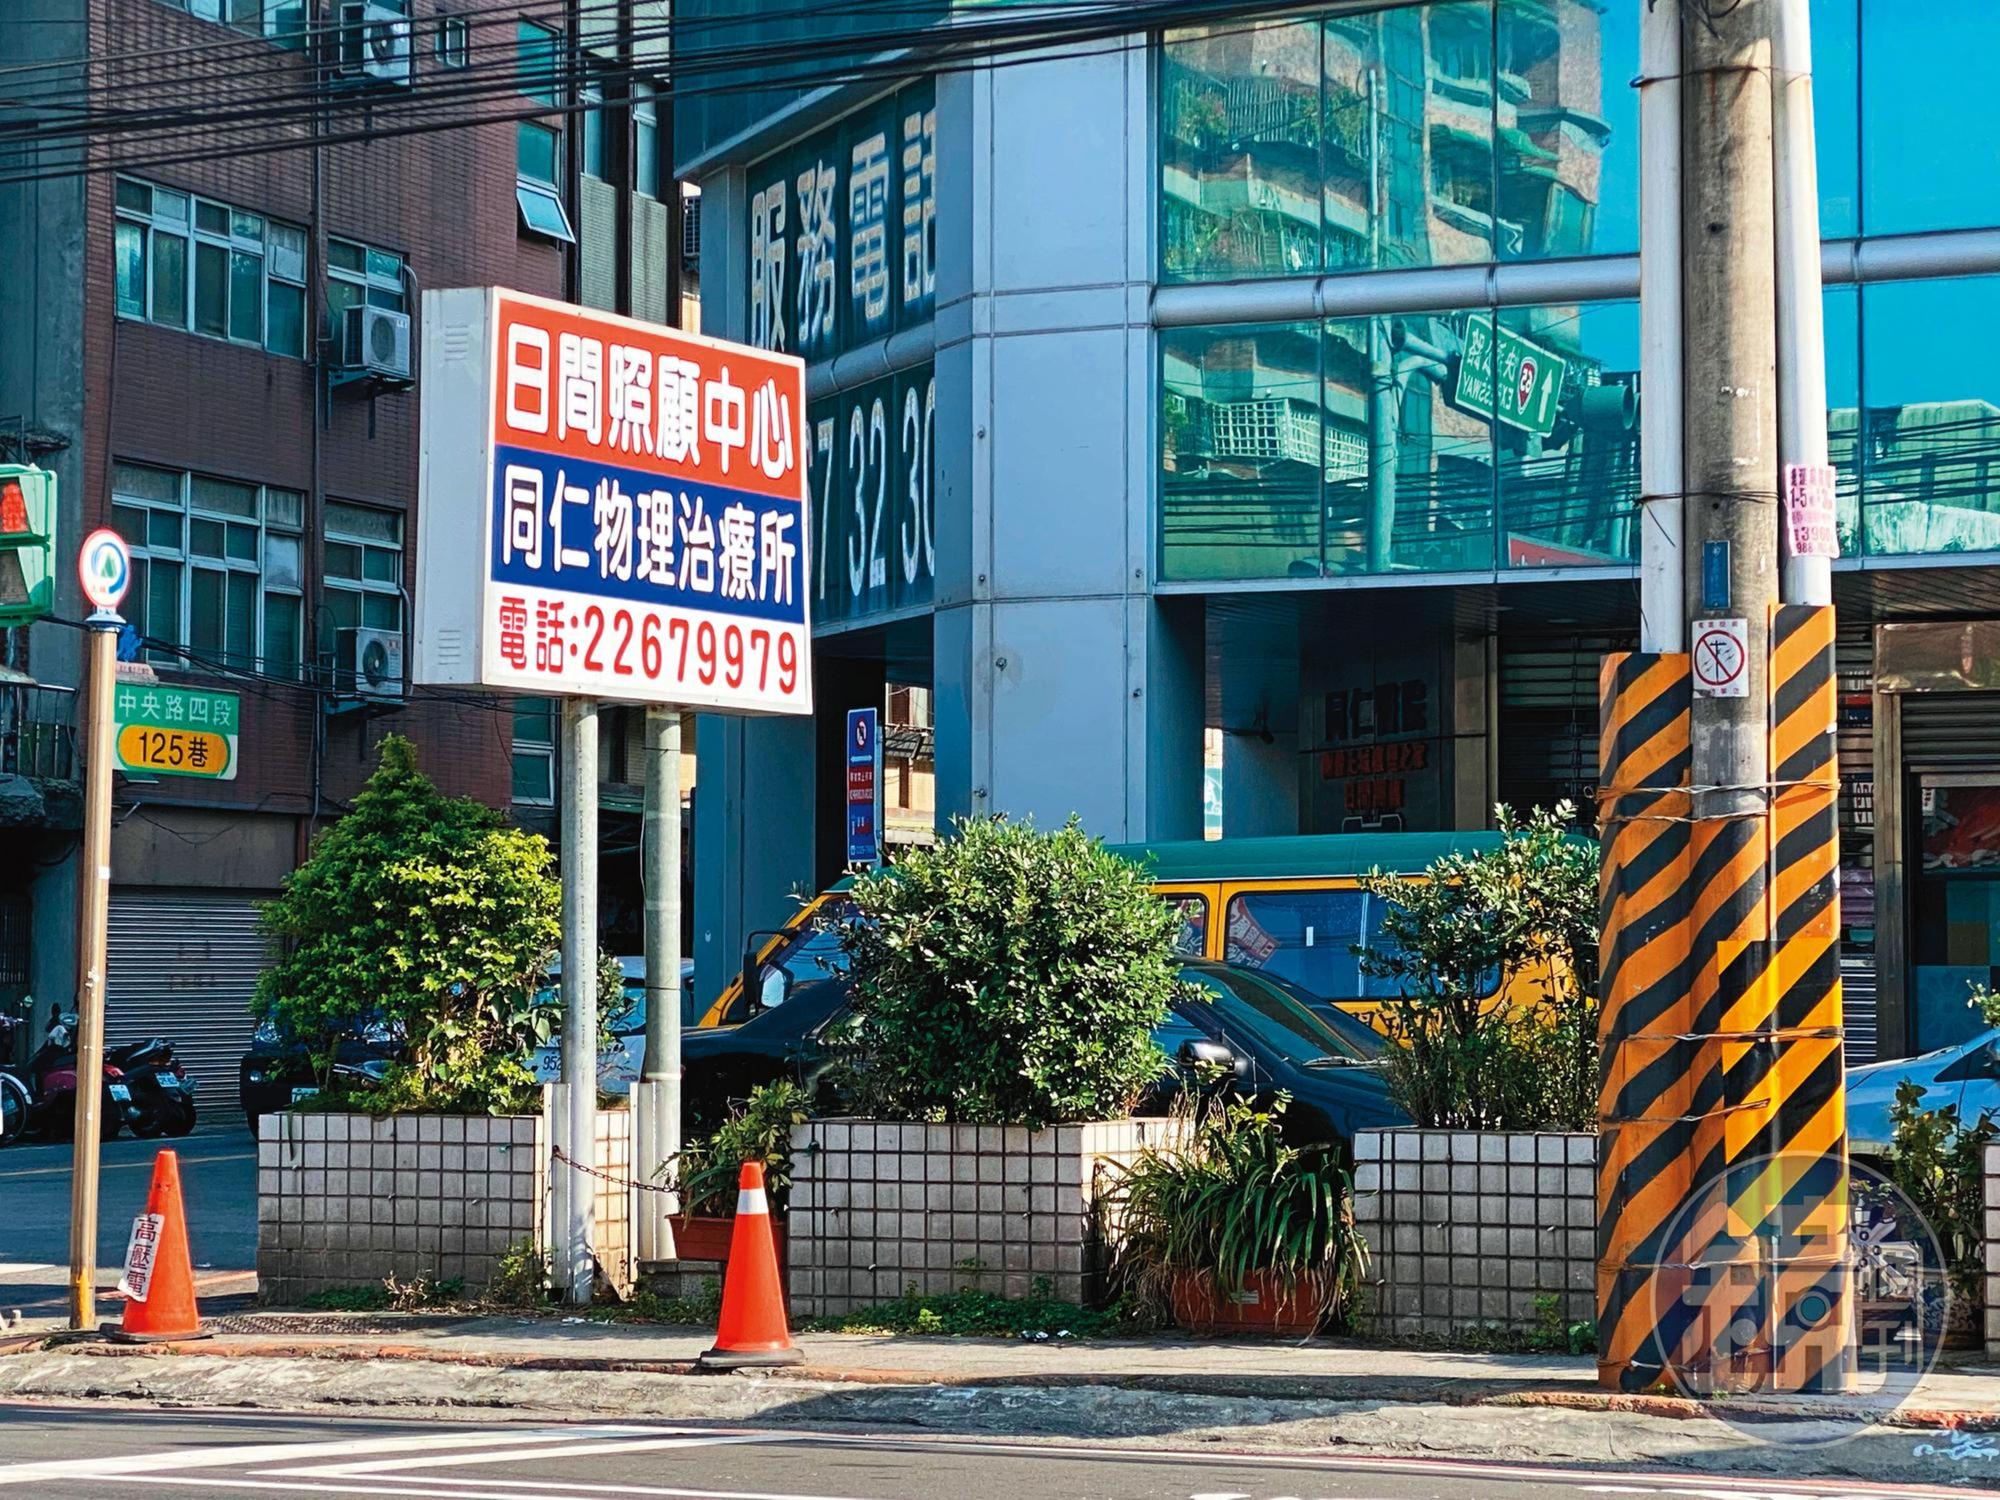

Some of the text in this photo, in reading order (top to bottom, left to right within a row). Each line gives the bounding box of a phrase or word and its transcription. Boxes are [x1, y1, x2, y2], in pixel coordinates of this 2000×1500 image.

[505, 322, 795, 480] 日間照顧中心
[502, 463, 796, 606] 同仁物理治療所
[118, 688, 232, 727] 中央路四段
[138, 731, 209, 768] 125巷
[127, 1215, 159, 1297] 高壓電
